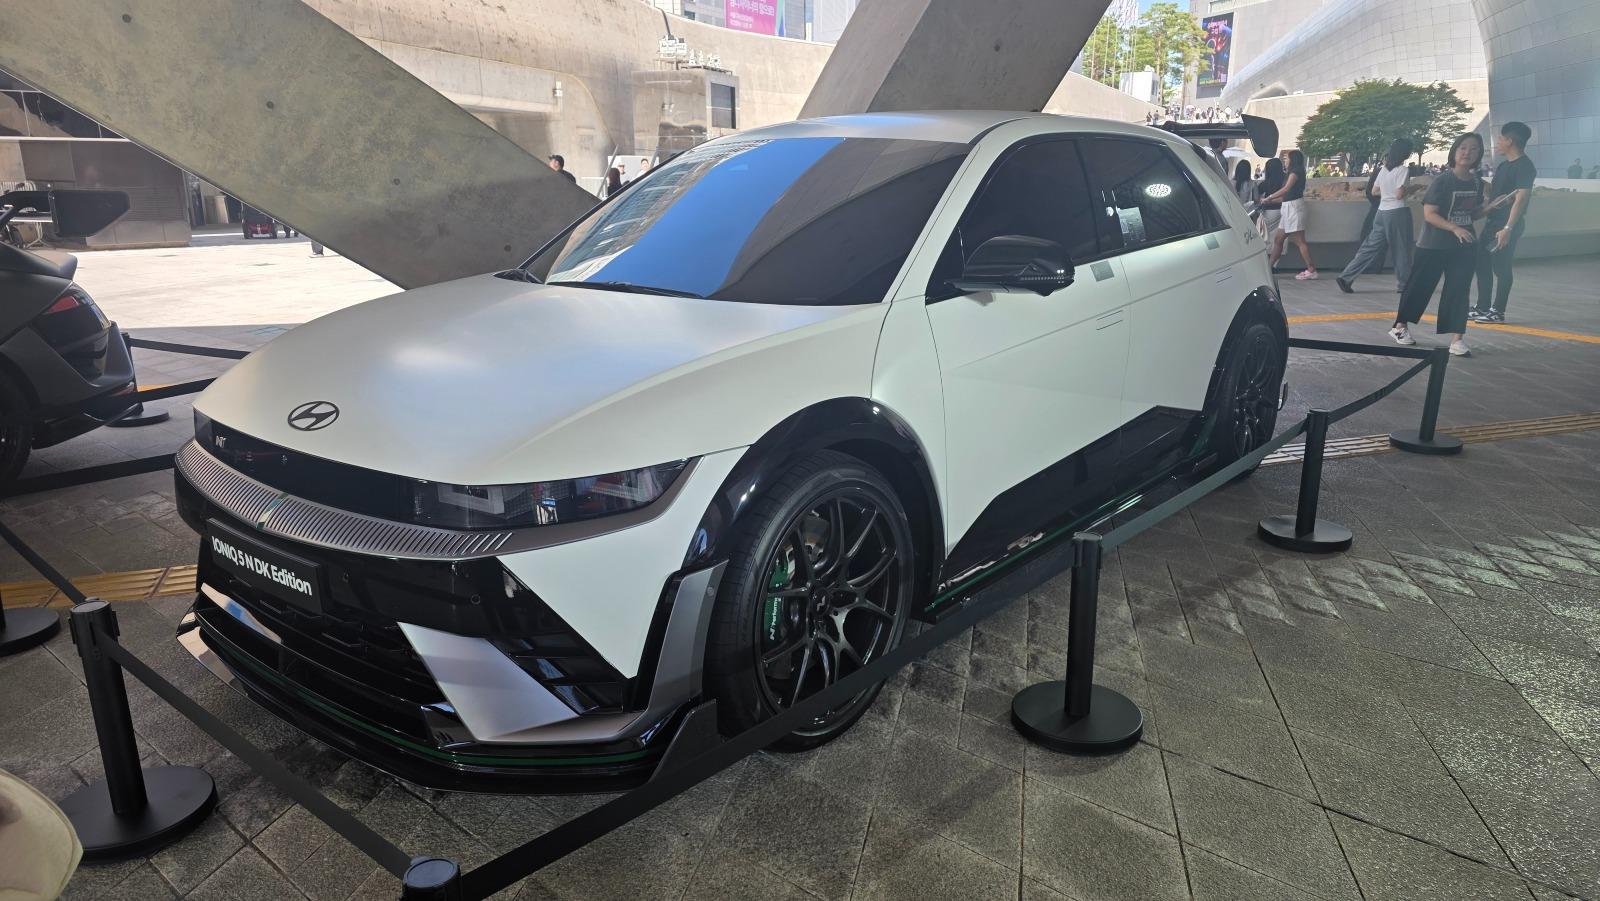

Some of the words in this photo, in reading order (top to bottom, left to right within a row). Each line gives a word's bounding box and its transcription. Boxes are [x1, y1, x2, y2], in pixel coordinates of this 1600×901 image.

[211, 536, 239, 566] IONIQ
[237, 550, 245, 567] 5
[244, 552, 255, 572] N
[254, 557, 272, 579] DK
[270, 564, 313, 596] Edition
